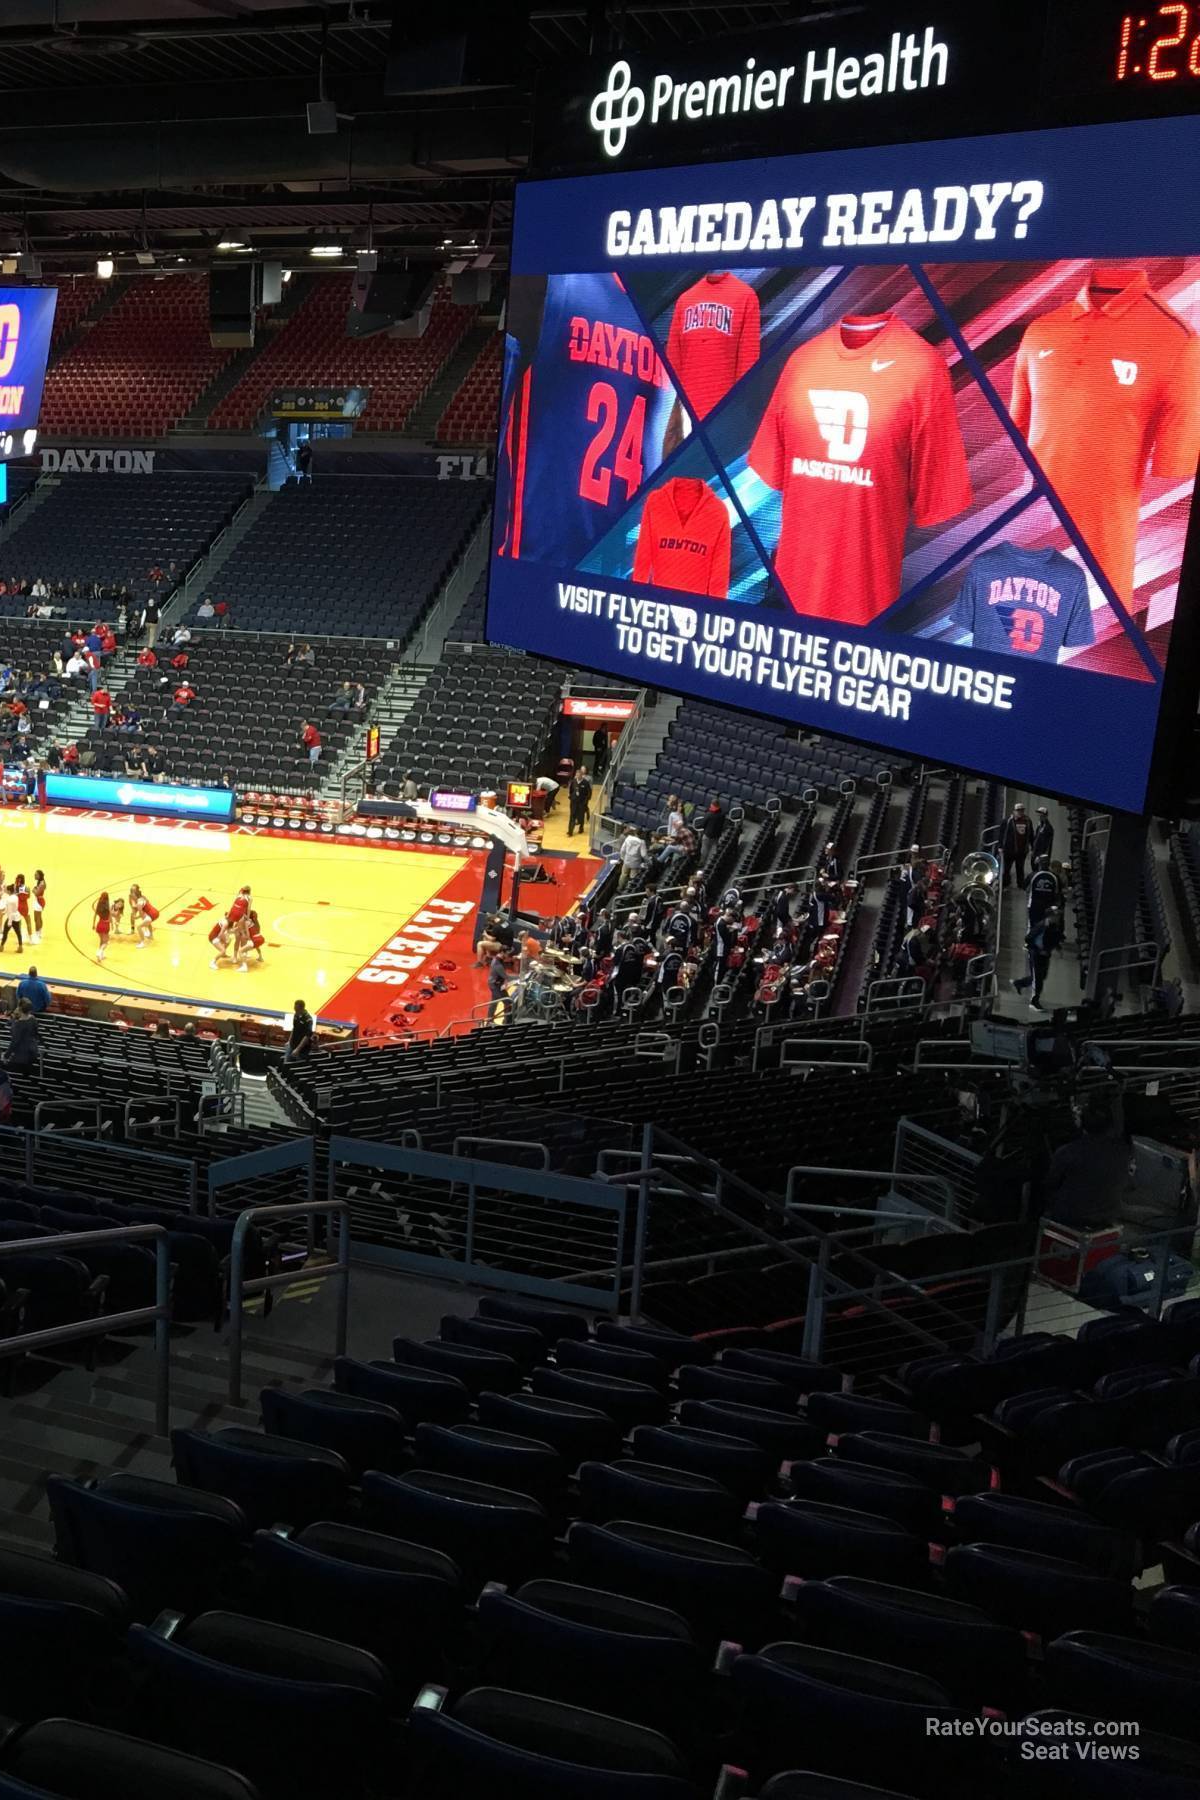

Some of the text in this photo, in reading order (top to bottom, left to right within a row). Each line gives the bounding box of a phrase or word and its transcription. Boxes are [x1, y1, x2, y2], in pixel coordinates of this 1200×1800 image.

[651, 26, 949, 124] Premier Health
[606, 180, 1044, 257] GAMEDAY READY?
[683, 302, 735, 336] DAYTON
[39, 449, 155, 475] DAYTON
[579, 381, 647, 506] 24
[792, 457, 874, 487] BASKETBALL
[987, 576, 1062, 617] DAYTON
[557, 583, 606, 616] VISIT
[608, 594, 669, 631] FLYER
[703, 613, 736, 644] UP
[738, 620, 774, 655] ON
[779, 628, 830, 668] THE
[833, 640, 1016, 710] CONCOURSE
[616, 624, 912, 721] TO GET YOUR FLYER GEAR
[78, 811, 267, 836] DAYTON
[356, 898, 476, 985] FLYERS
